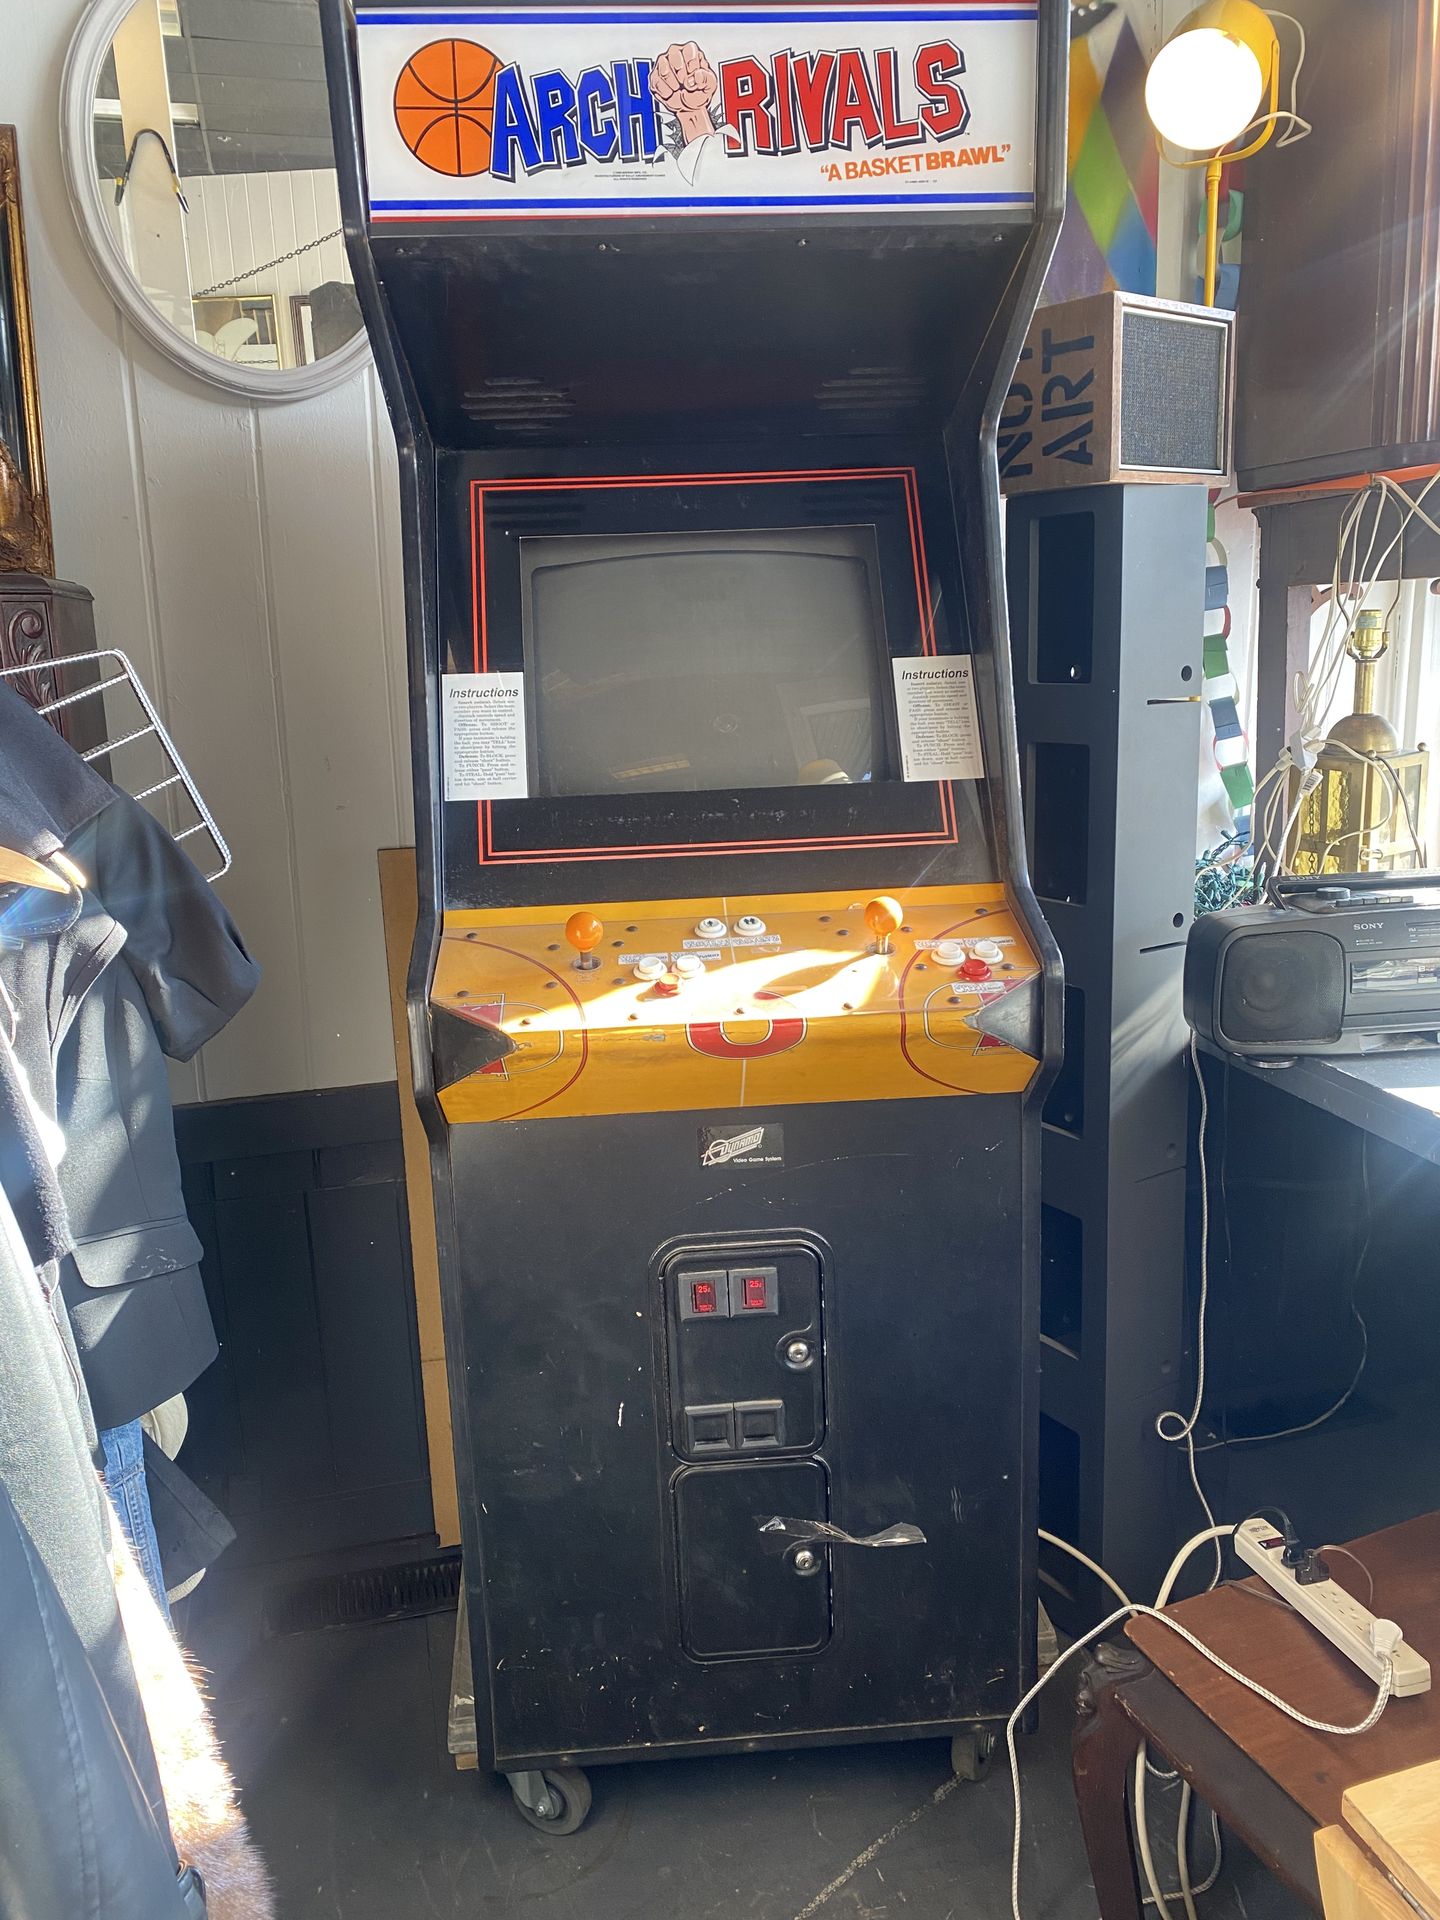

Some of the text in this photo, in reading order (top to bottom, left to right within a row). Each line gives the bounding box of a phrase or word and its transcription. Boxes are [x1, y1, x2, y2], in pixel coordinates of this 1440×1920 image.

[489, 38, 971, 183] ARCH RIVALS
[1041, 328, 1095, 466] ART
[902, 668, 969, 680] Instructions
[449, 687, 519, 699] Instructions
[1353, 922, 1384, 931] SONY
